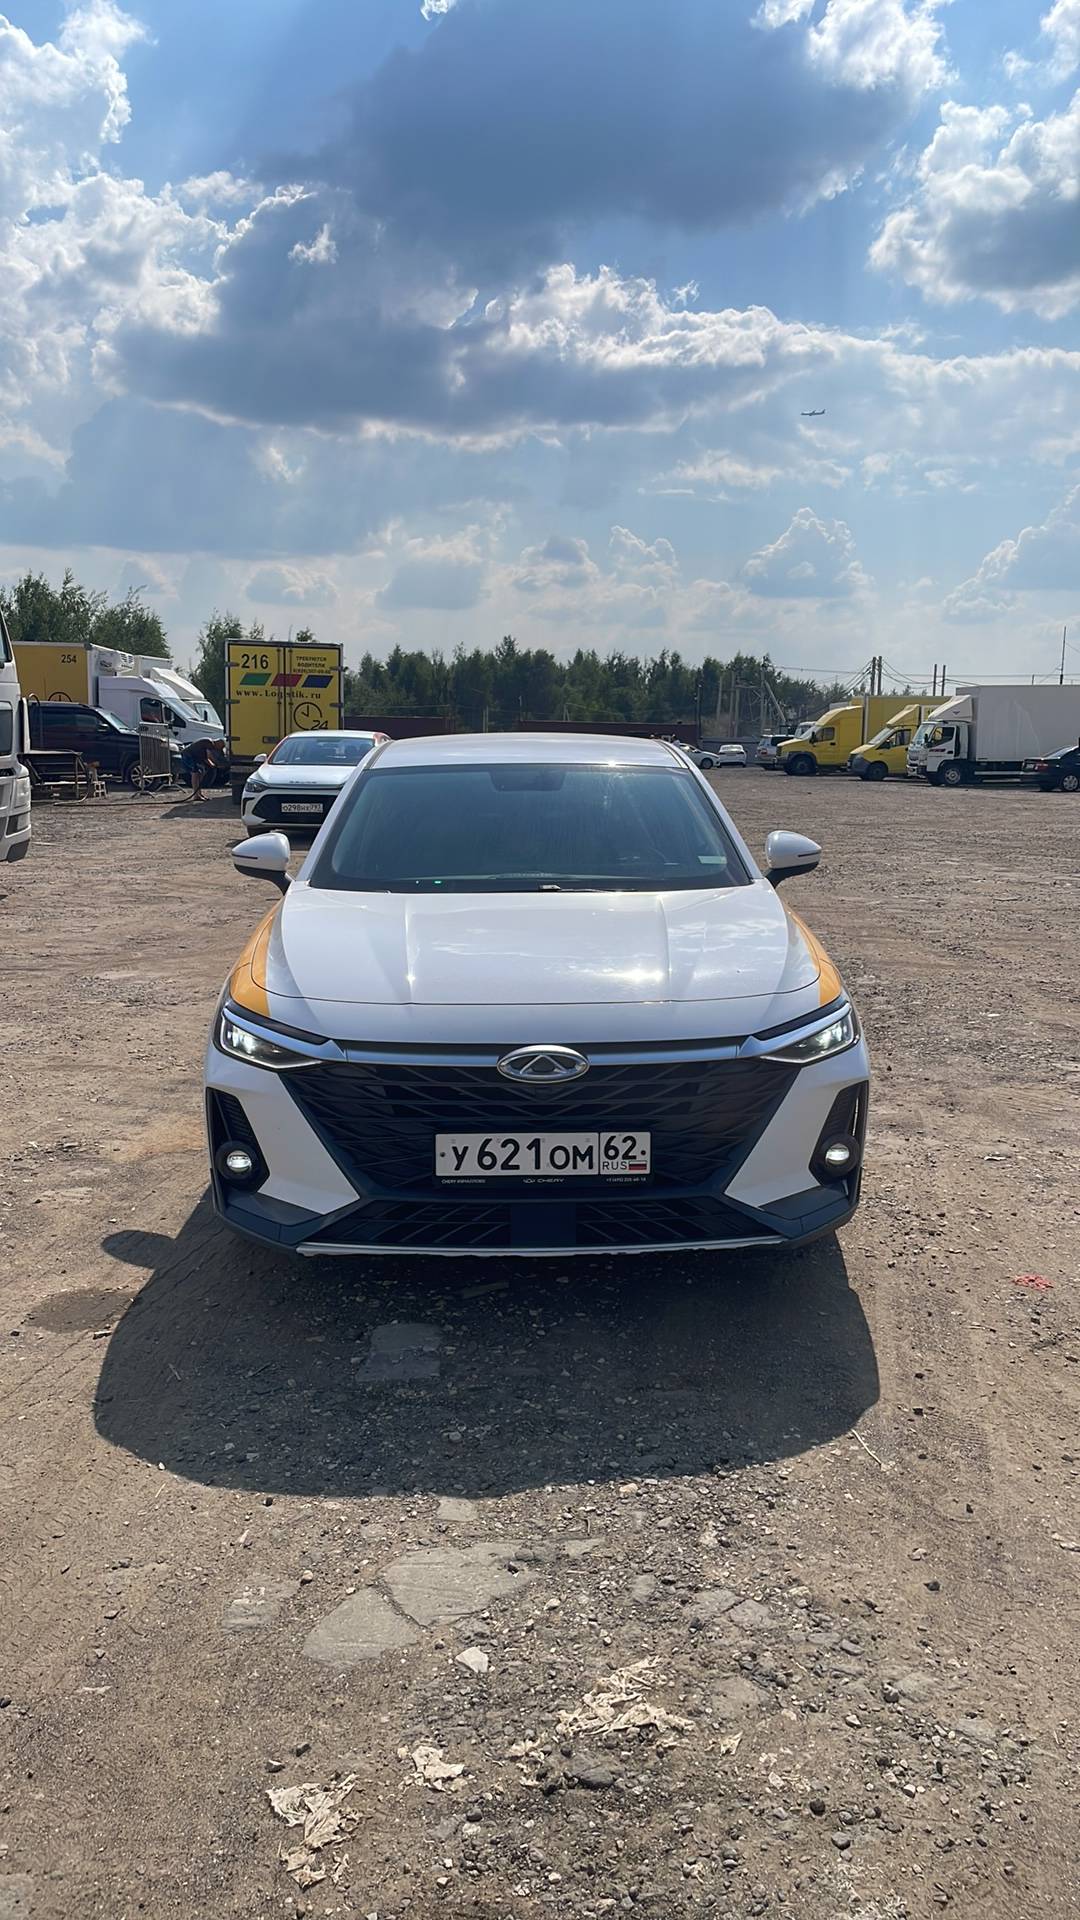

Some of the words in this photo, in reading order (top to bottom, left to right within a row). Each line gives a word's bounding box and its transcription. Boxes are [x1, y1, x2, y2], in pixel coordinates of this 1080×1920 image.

[61, 654, 77, 664] 254
[241, 653, 269, 669] 216
[311, 719, 328, 730] 24
[603, 1135, 637, 1160] 62
[602, 1160, 628, 1170] RUS
